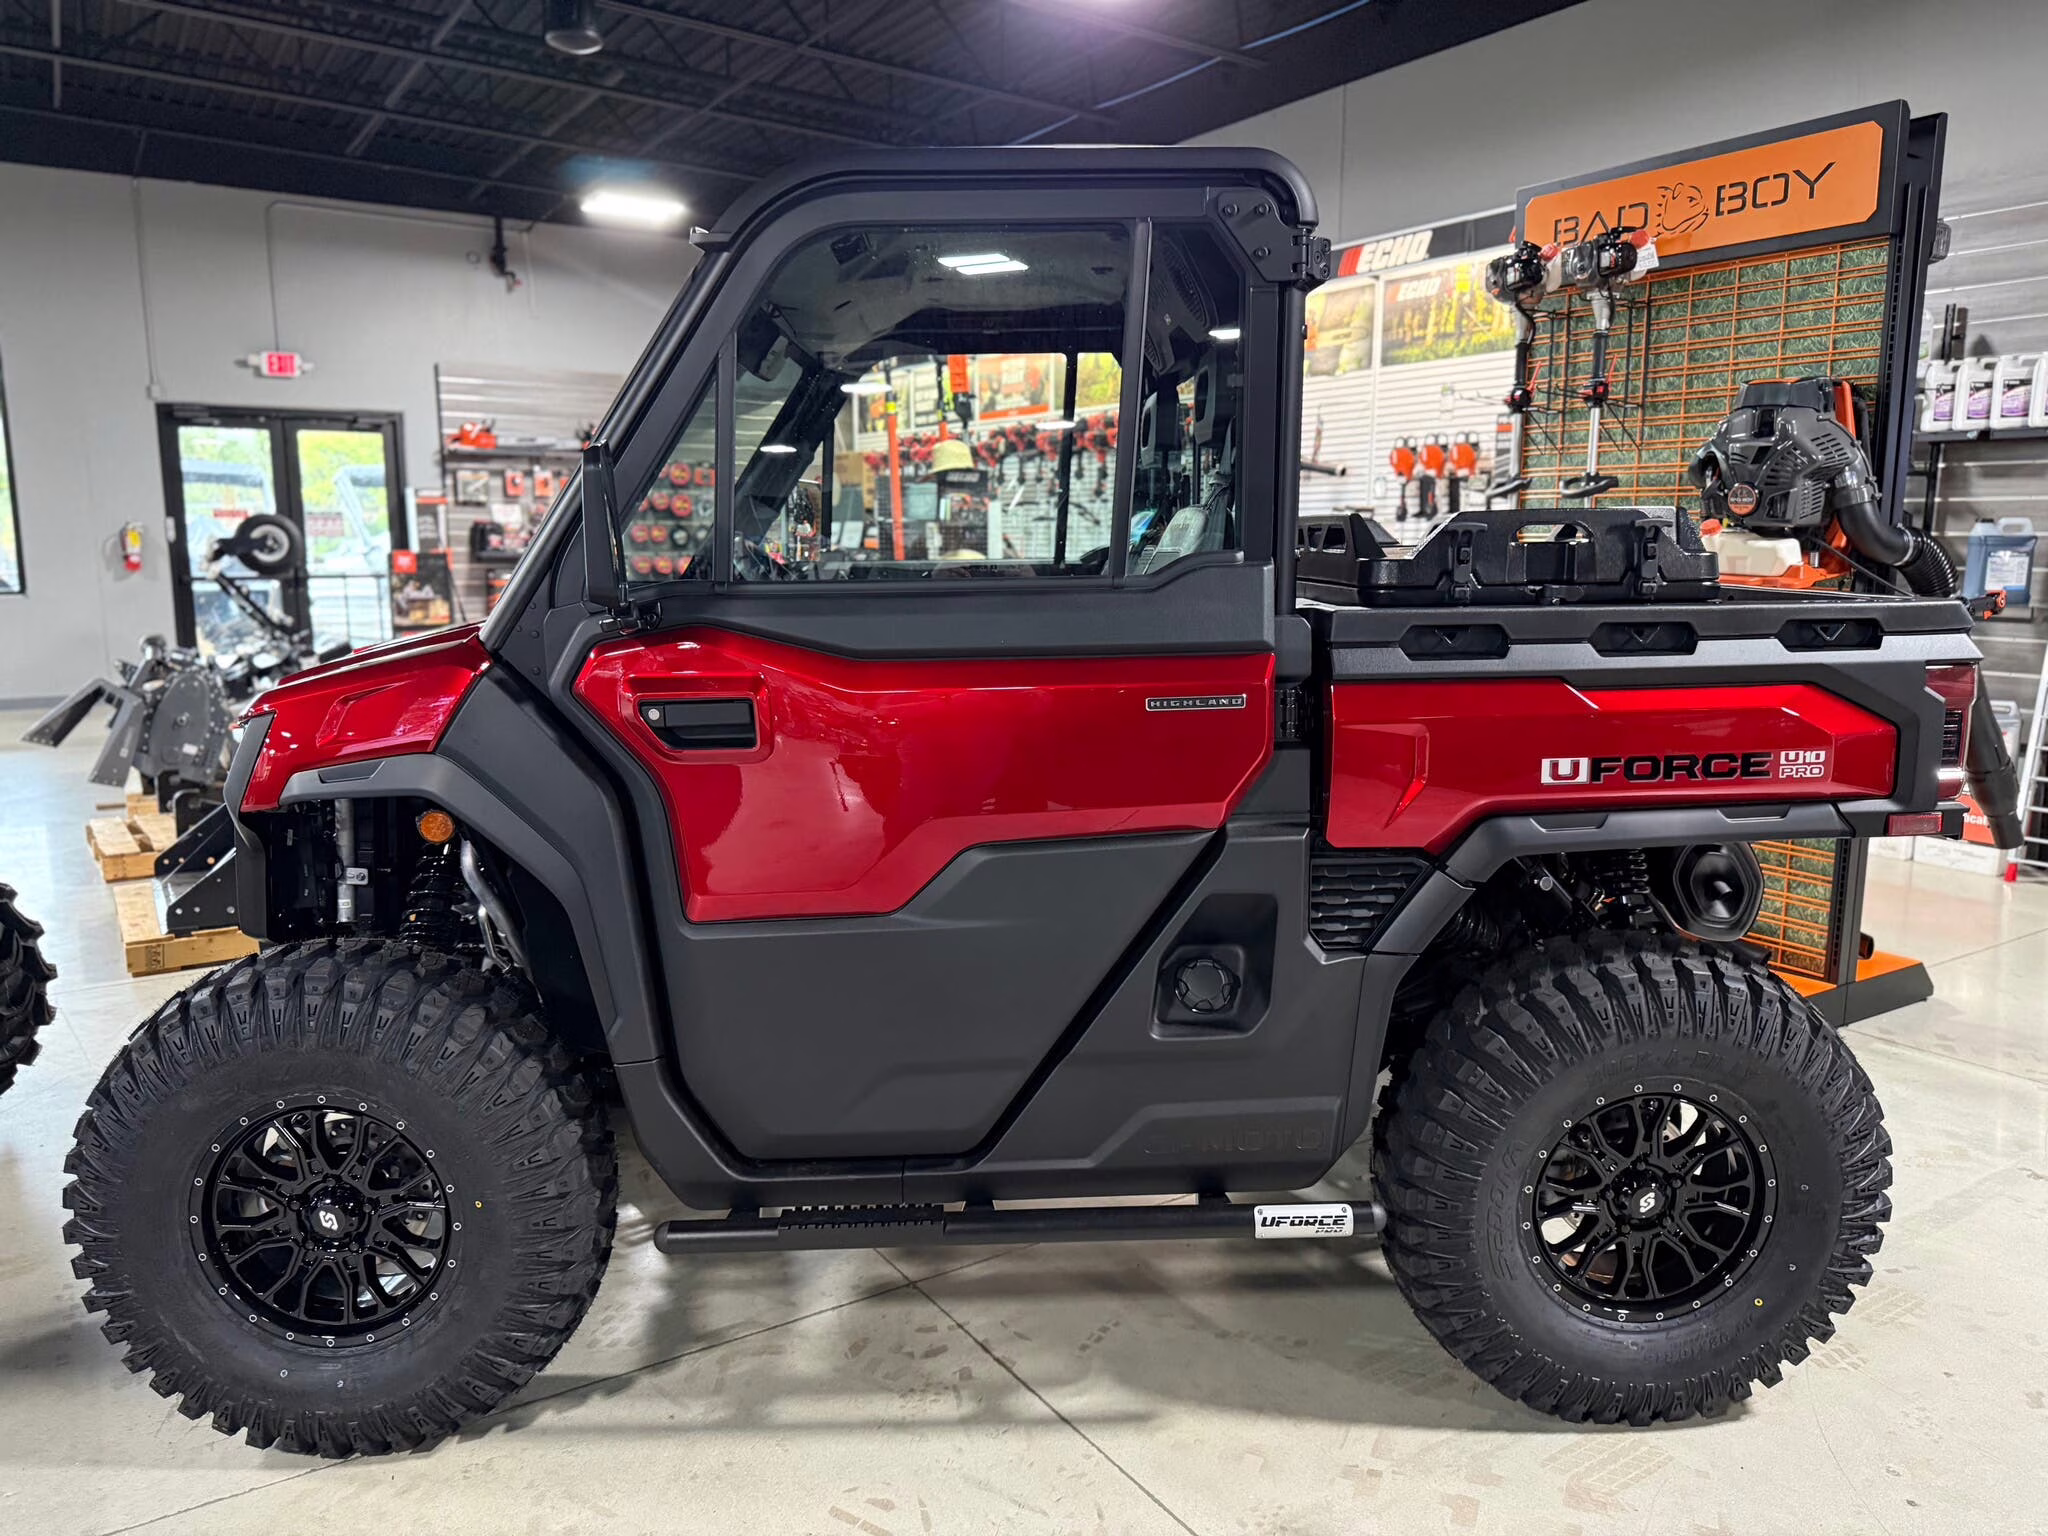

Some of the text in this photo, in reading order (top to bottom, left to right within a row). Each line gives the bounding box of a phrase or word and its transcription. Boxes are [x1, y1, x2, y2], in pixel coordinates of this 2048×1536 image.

[1553, 161, 1838, 246] BAD BOY
[1398, 276, 1441, 302] ECHO
[1150, 698, 1243, 707] HIGHLAND
[1780, 751, 1826, 765] U10
[1779, 765, 1825, 779] PRO
[1260, 1215, 1348, 1228] UFORCE
